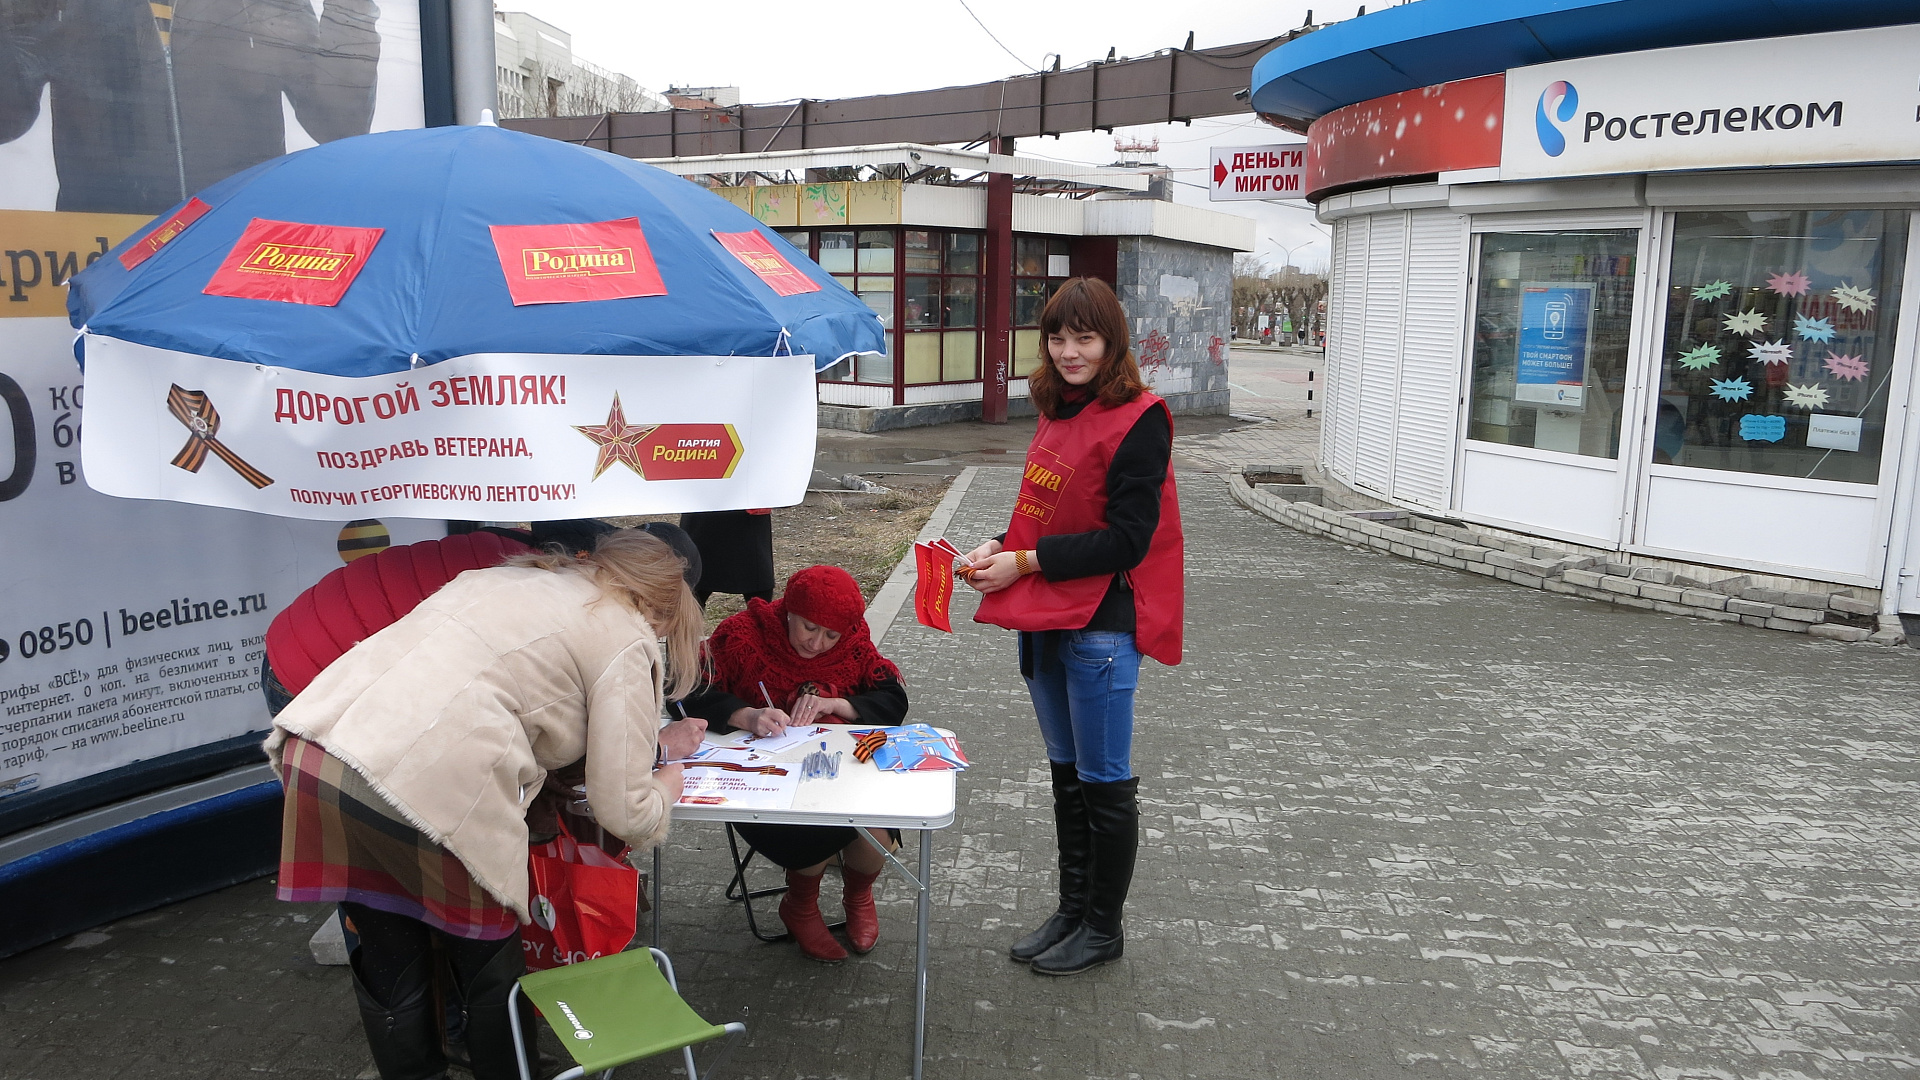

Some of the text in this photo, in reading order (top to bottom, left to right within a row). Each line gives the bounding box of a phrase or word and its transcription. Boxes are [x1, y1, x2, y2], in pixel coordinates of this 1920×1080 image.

[1583, 101, 1843, 143] Ростелеком
[1231, 150, 1303, 173] ДЕНЬГИ
[1235, 174, 1299, 192] МИГОМ
[250, 246, 342, 272] Родина
[530, 251, 625, 272] Родина
[1521, 359, 1573, 369] МОЖЕТ БОЛЬШЕ!
[1522, 351, 1573, 361] ТВОЙ СМАРТФОН
[274, 374, 568, 425] ДОРОГОЙ ЗЕМЛЯК!
[316, 436, 534, 470] ПОЗДРАВЬ ВЕТЕРАНА,
[677, 438, 721, 448] ПАРТИЯ
[1024, 461, 1062, 492] ина
[289, 483, 577, 506] ПОЛУЧИ ГЕОРГИЕВСКУЮ ЛЕНТОЧКУ!
[1020, 503, 1045, 519] край
[19, 618, 94, 659] 0850
[118, 592, 268, 636] beeline.ru
[48, 668, 90, 690] «ВСЁ!»
[97, 664, 118, 680] для
[125, 646, 200, 673] физических
[207, 641, 234, 654] лиц,
[6, 692, 75, 717] интернет.
[100, 679, 126, 693] коп.
[135, 673, 150, 684] на
[159, 658, 219, 678] безлимит
[228, 655, 235, 665] в
[77, 696, 118, 716] пакета
[122, 686, 164, 703] минут,
[169, 668, 249, 692] включенных
[253, 666, 260, 675] в
[1, 729, 59, 752] порядок
[61, 712, 120, 736] списания
[122, 691, 203, 719] абонентской
[204, 684, 245, 701] платы,
[3, 748, 49, 771] тариф,
[71, 738, 87, 750] на
[90, 711, 186, 745] www.beeline.ru
